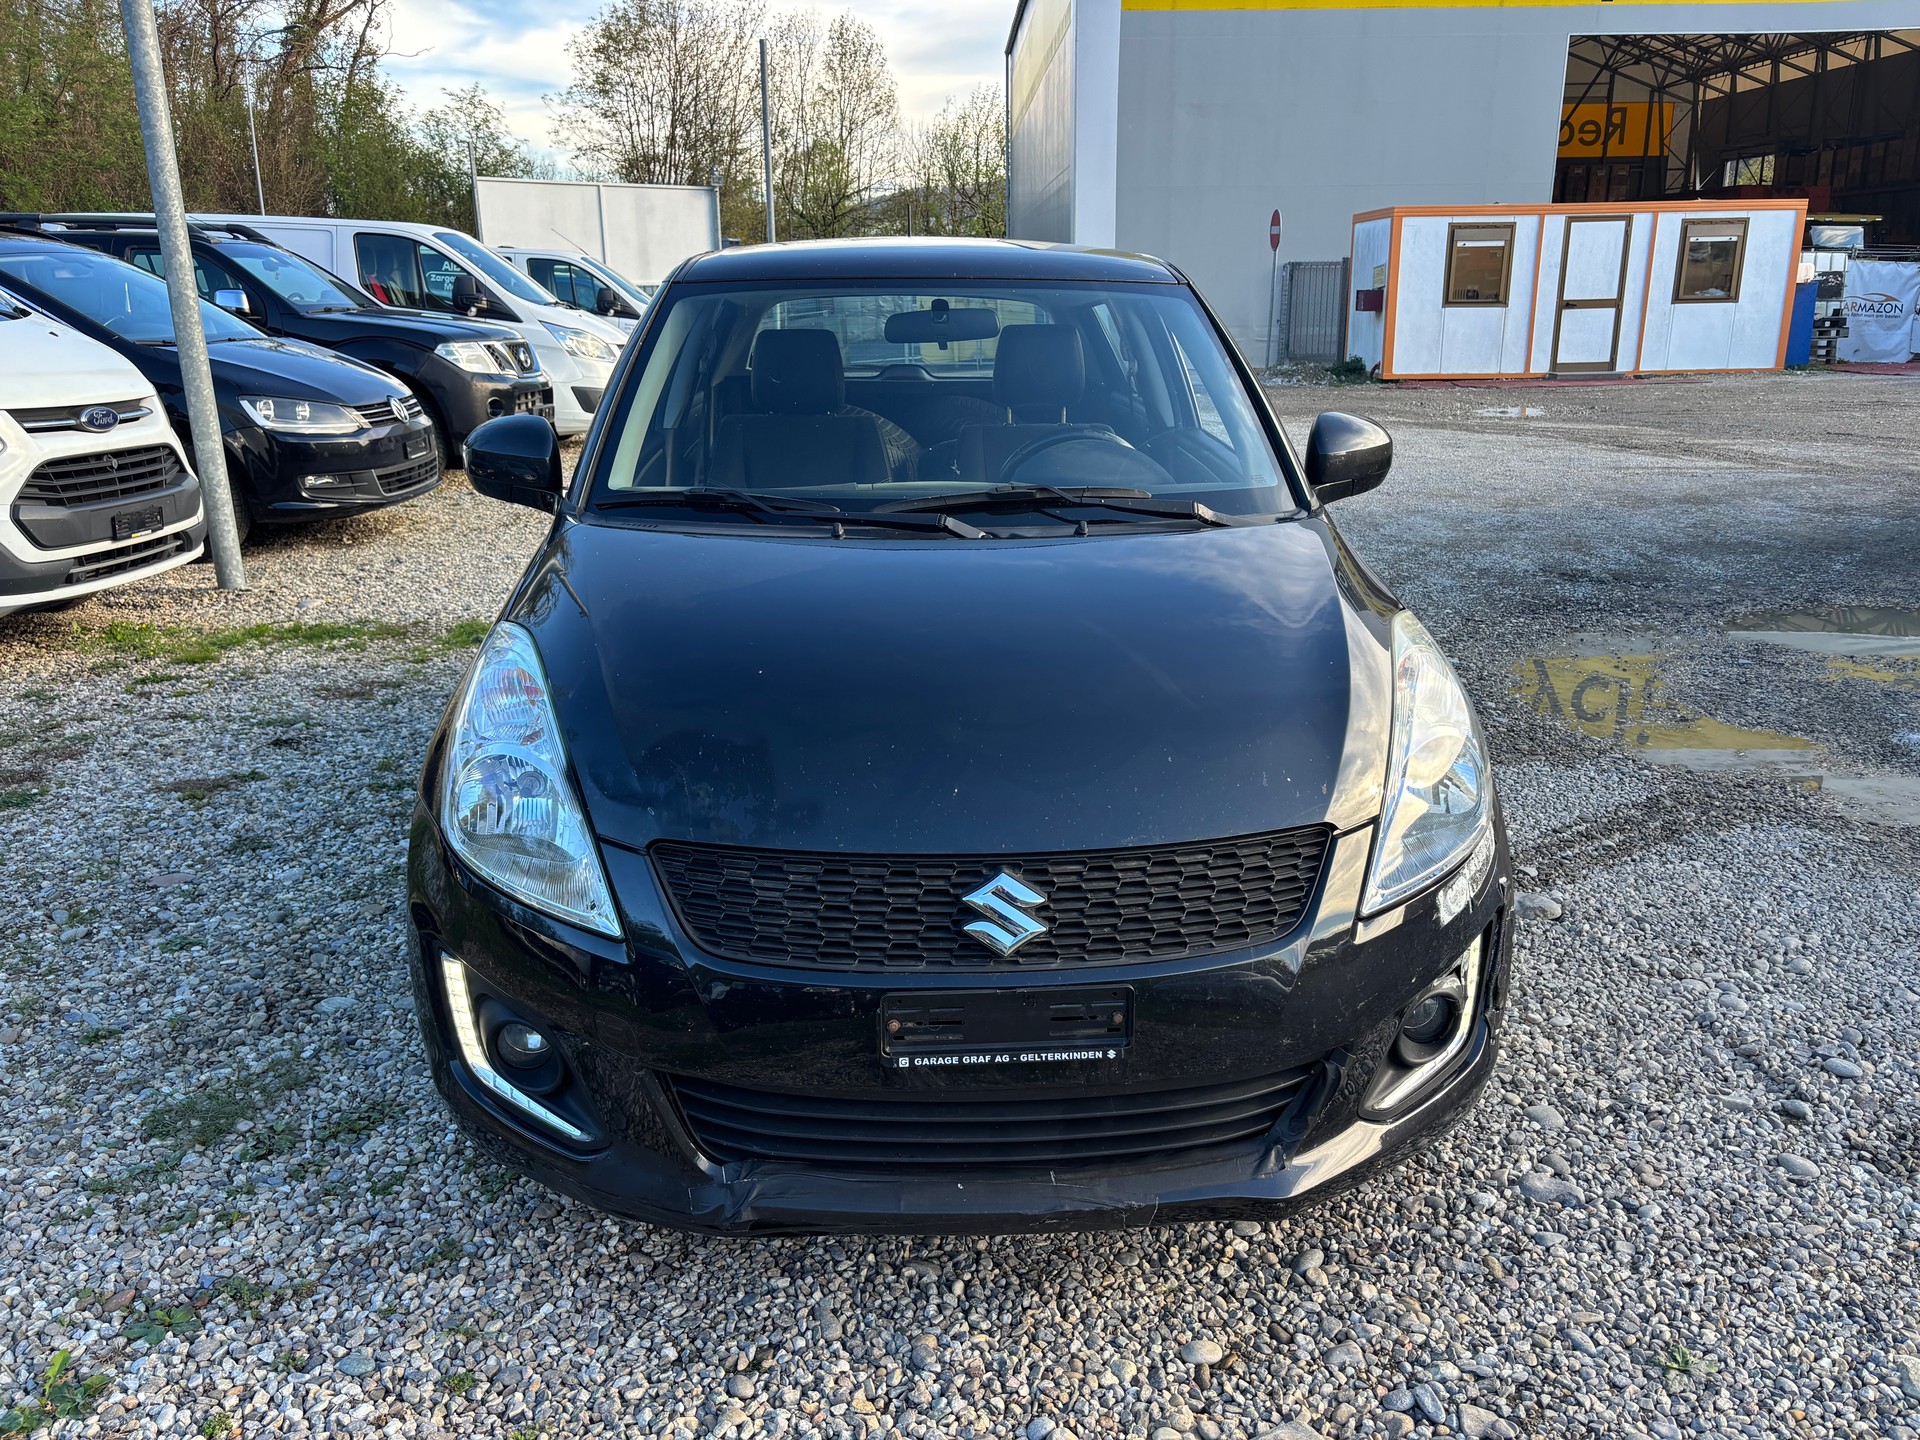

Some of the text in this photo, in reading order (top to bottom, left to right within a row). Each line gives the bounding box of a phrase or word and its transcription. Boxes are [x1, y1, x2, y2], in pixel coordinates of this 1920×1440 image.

[93, 410, 115, 426] Ford
[914, 1056, 959, 1066] GARAGE
[962, 1055, 992, 1064] GRAF
[994, 1054, 1010, 1063] AG
[1020, 1051, 1103, 1062] GELTERKINDEN
